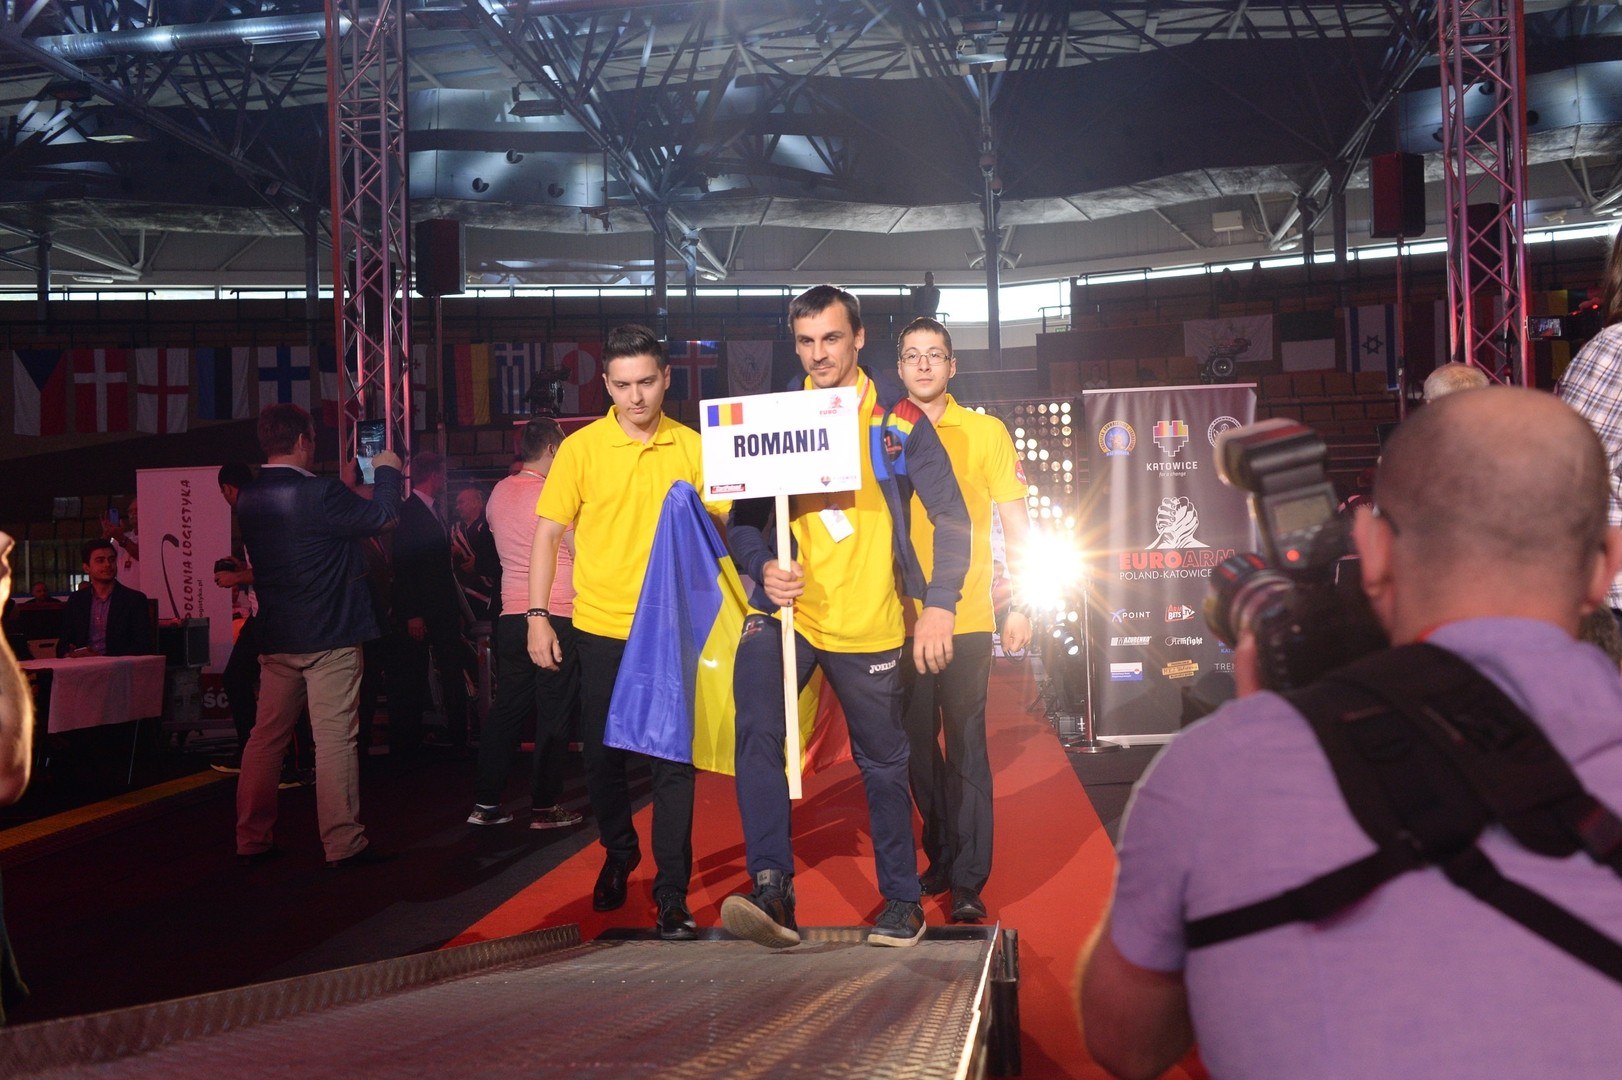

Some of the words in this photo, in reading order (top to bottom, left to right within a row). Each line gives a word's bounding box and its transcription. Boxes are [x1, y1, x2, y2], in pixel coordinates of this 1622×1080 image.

[733, 428, 830, 458] ROMANIA
[1146, 461, 1198, 471] KATOWICE
[180, 479, 192, 557] LOGISTYKA
[1119, 568, 1213, 581] POLAND-KATOWICE
